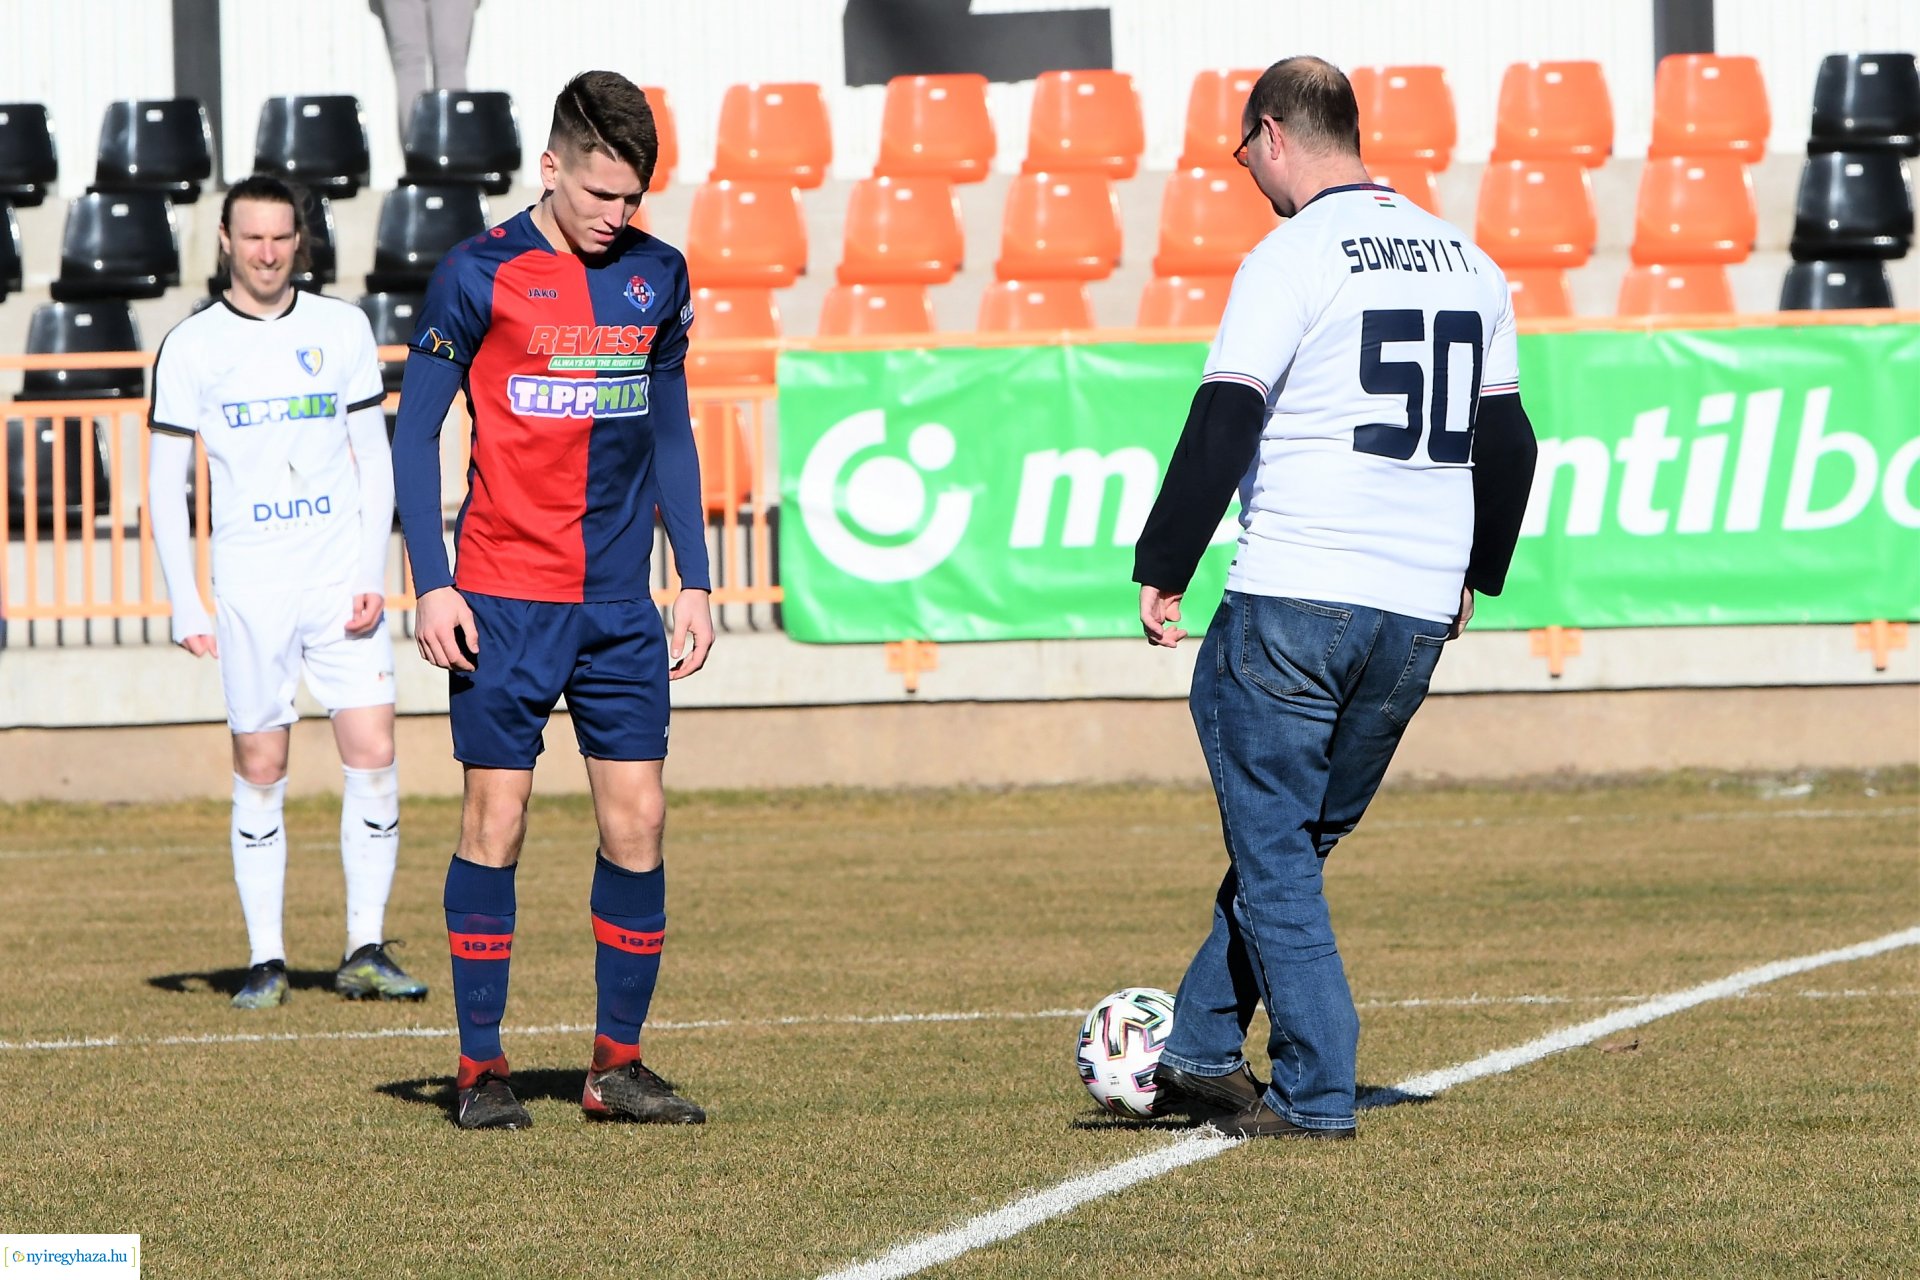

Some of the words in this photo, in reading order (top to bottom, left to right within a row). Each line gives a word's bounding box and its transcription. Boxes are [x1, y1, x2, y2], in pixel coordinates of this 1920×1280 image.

[1341, 236, 1454, 274] SOMOGYI
[1454, 240, 1479, 275] T.
[528, 287, 558, 300] JAKO
[551, 358, 584, 367] ALWAYS
[584, 358, 596, 367] ON
[596, 358, 611, 367] THE
[611, 358, 633, 367] RIGHT
[632, 358, 645, 366] WAY
[1353, 308, 1484, 465] 50
